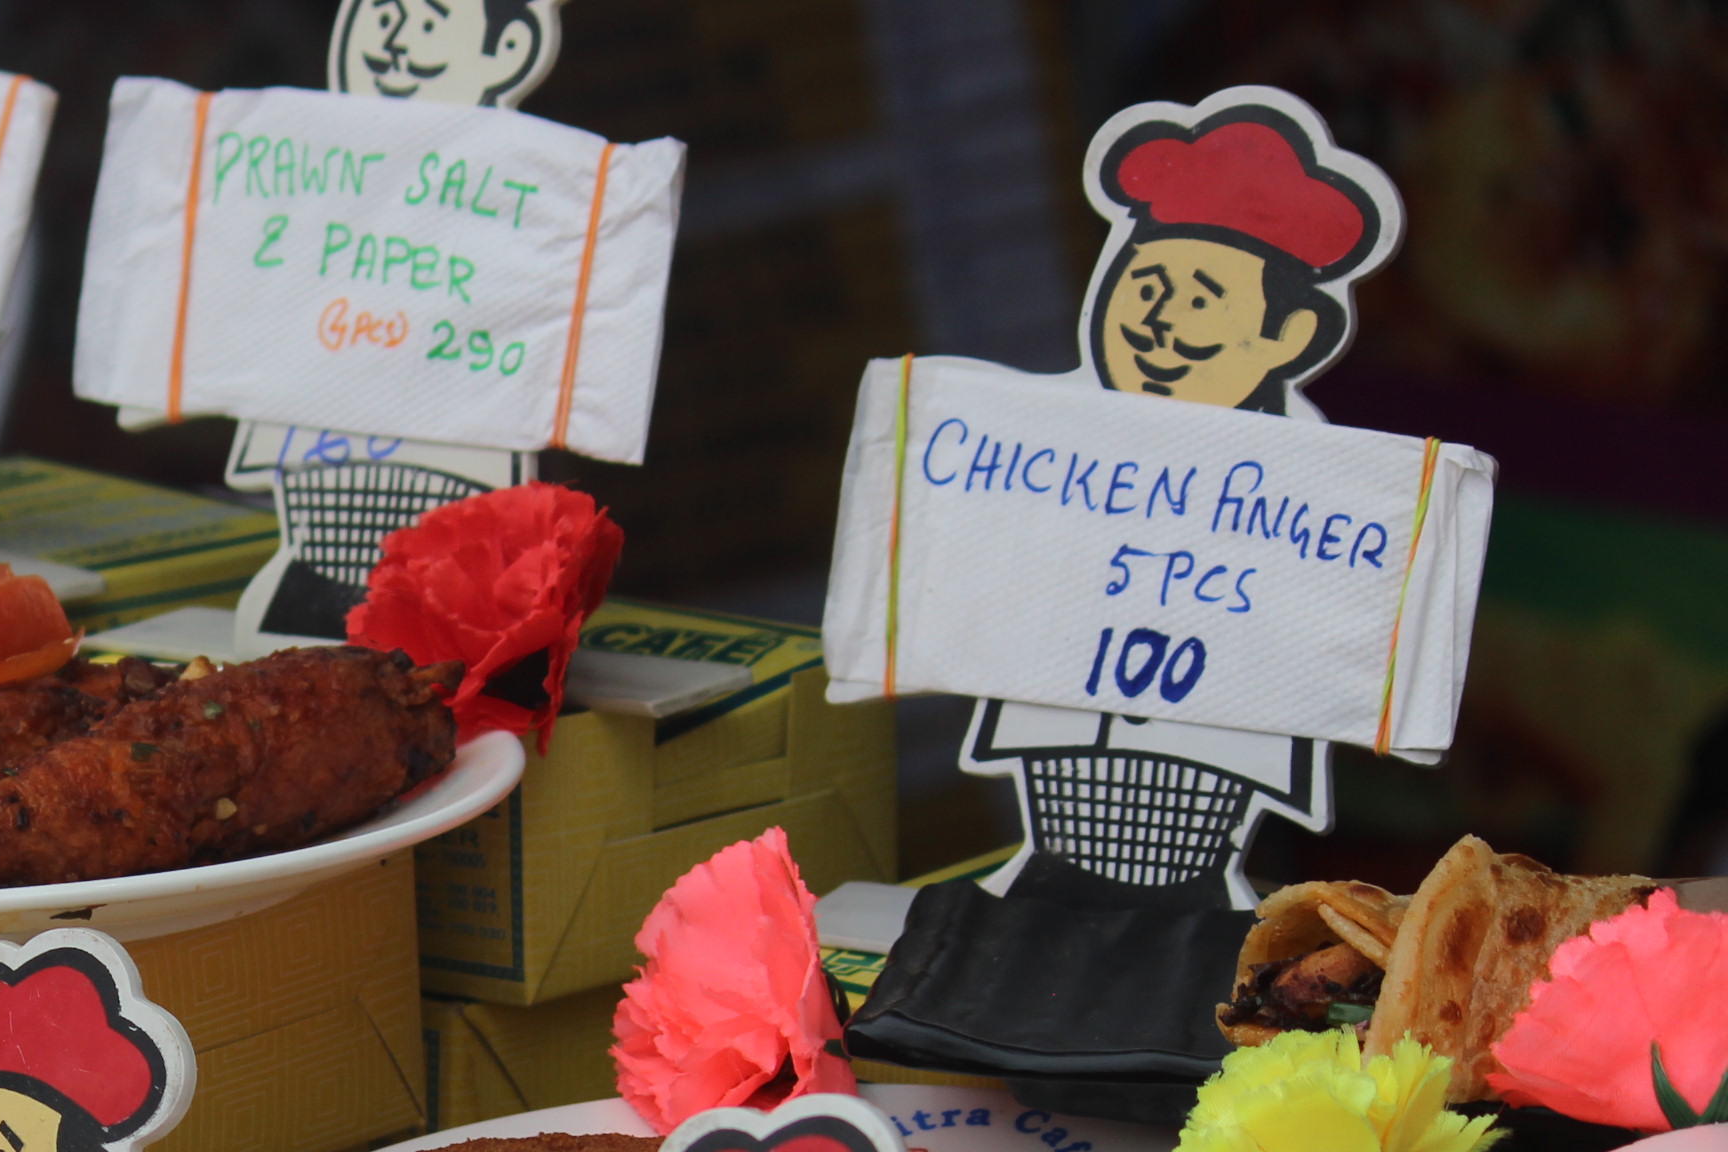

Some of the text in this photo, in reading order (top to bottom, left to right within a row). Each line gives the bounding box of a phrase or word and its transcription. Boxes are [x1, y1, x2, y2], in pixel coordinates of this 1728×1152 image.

[213, 131, 539, 229] PRAWN SALT
[319, 222, 476, 304] PAPER
[426, 319, 526, 376] 290
[921, 418, 1197, 518] CHICKEN
[1084, 626, 1208, 704] 100
[890, 1105, 991, 1137] itra
